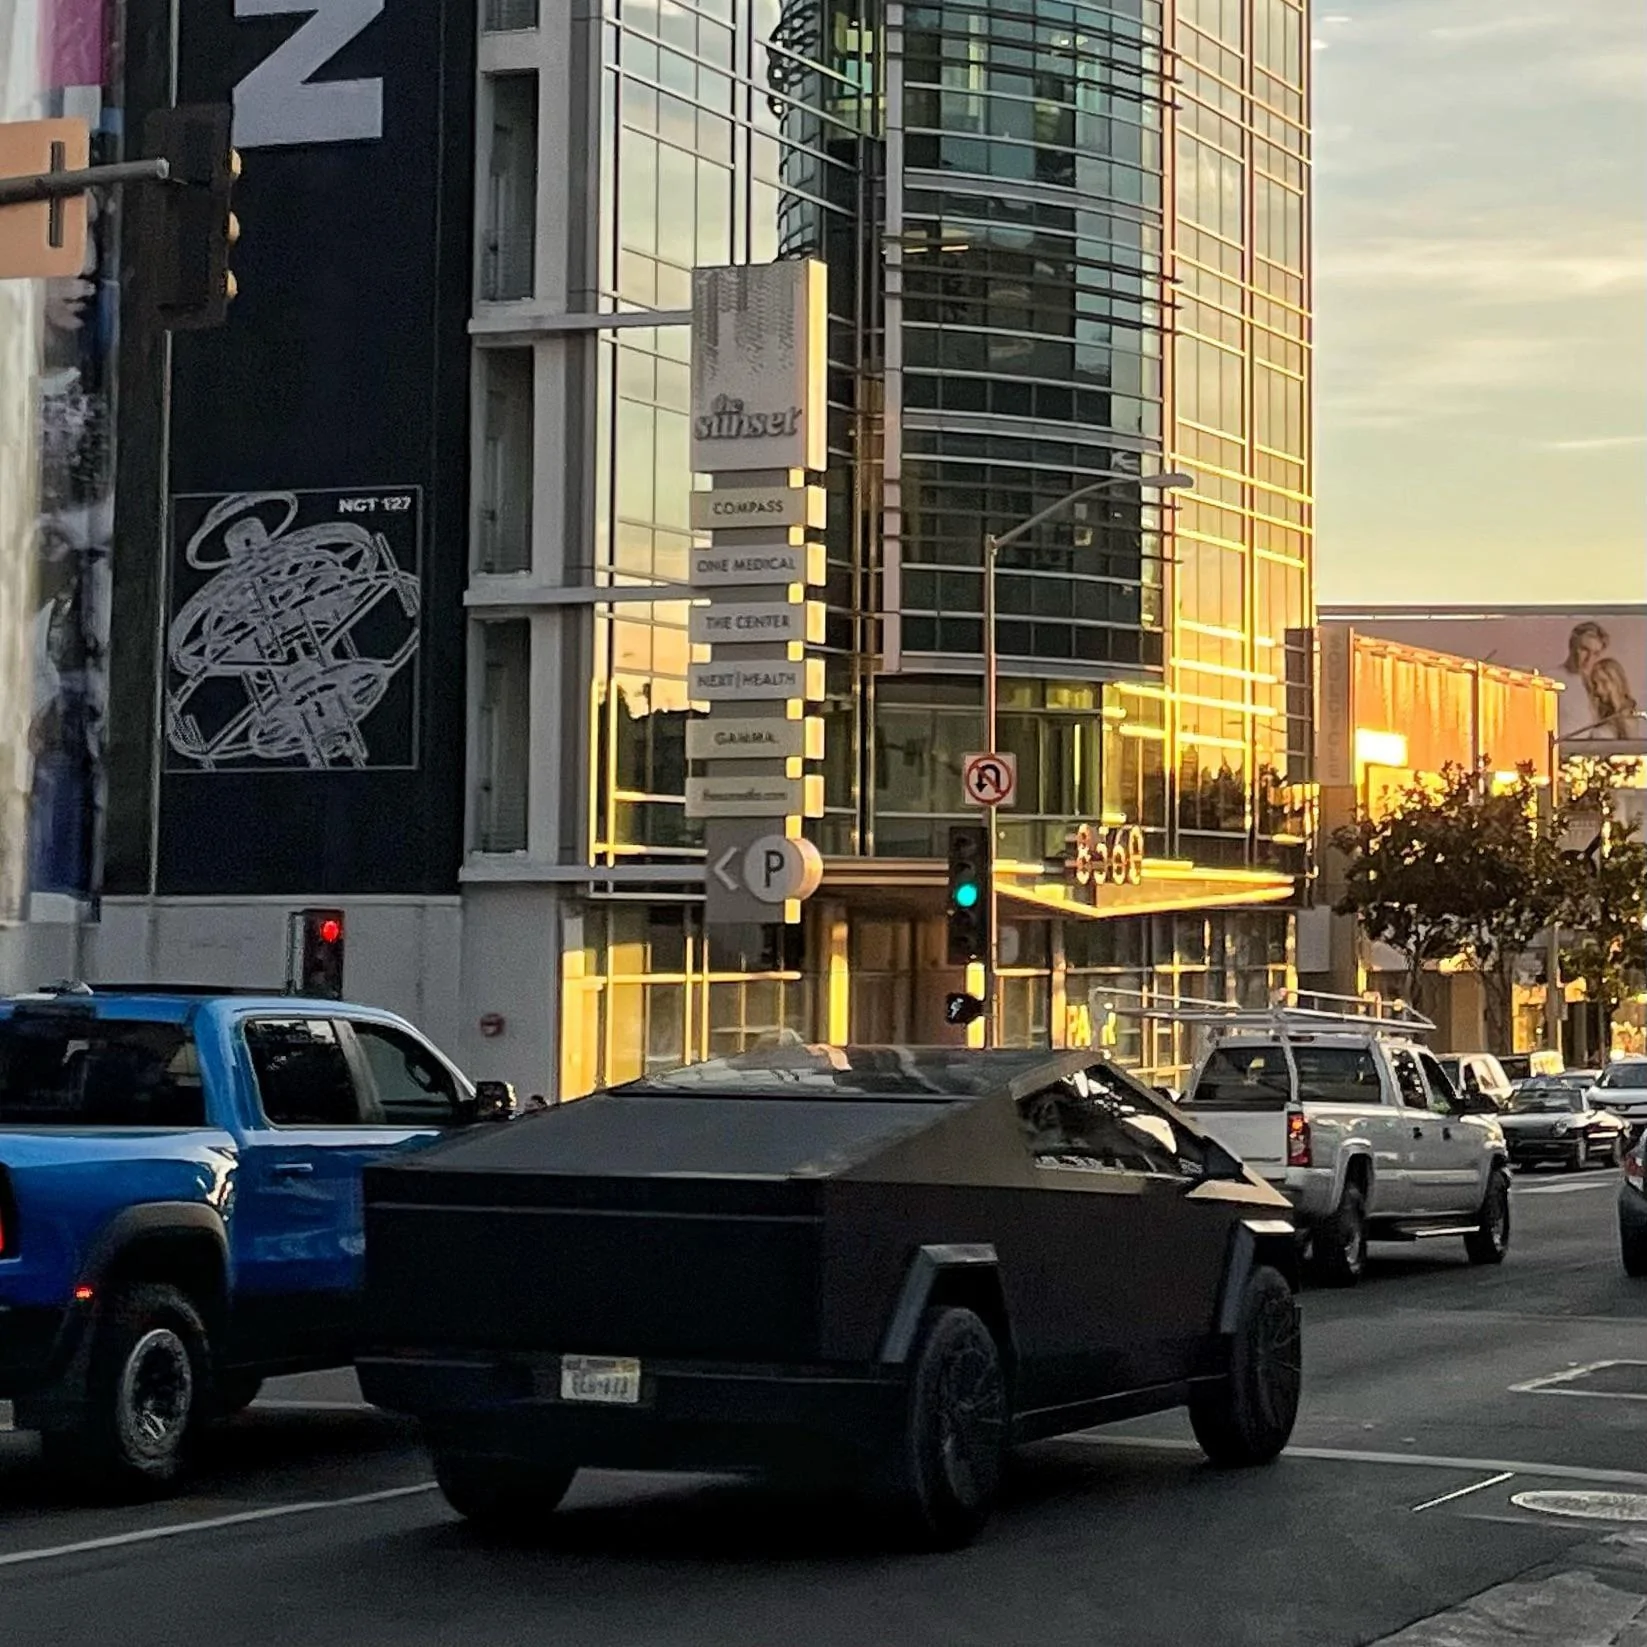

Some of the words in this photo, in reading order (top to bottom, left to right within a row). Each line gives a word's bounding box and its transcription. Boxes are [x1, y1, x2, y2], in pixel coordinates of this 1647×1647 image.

[694, 406, 802, 440] sunset
[381, 496, 412, 512] 127
[712, 500, 784, 516] COMPASS
[697, 559, 730, 573] ONE
[733, 556, 797, 573] MEDICAL
[706, 616, 731, 631] THE
[735, 614, 791, 630] CENTER
[1076, 823, 1144, 885] 8560
[765, 849, 786, 889] P
[1066, 1004, 1117, 1047] PAK
